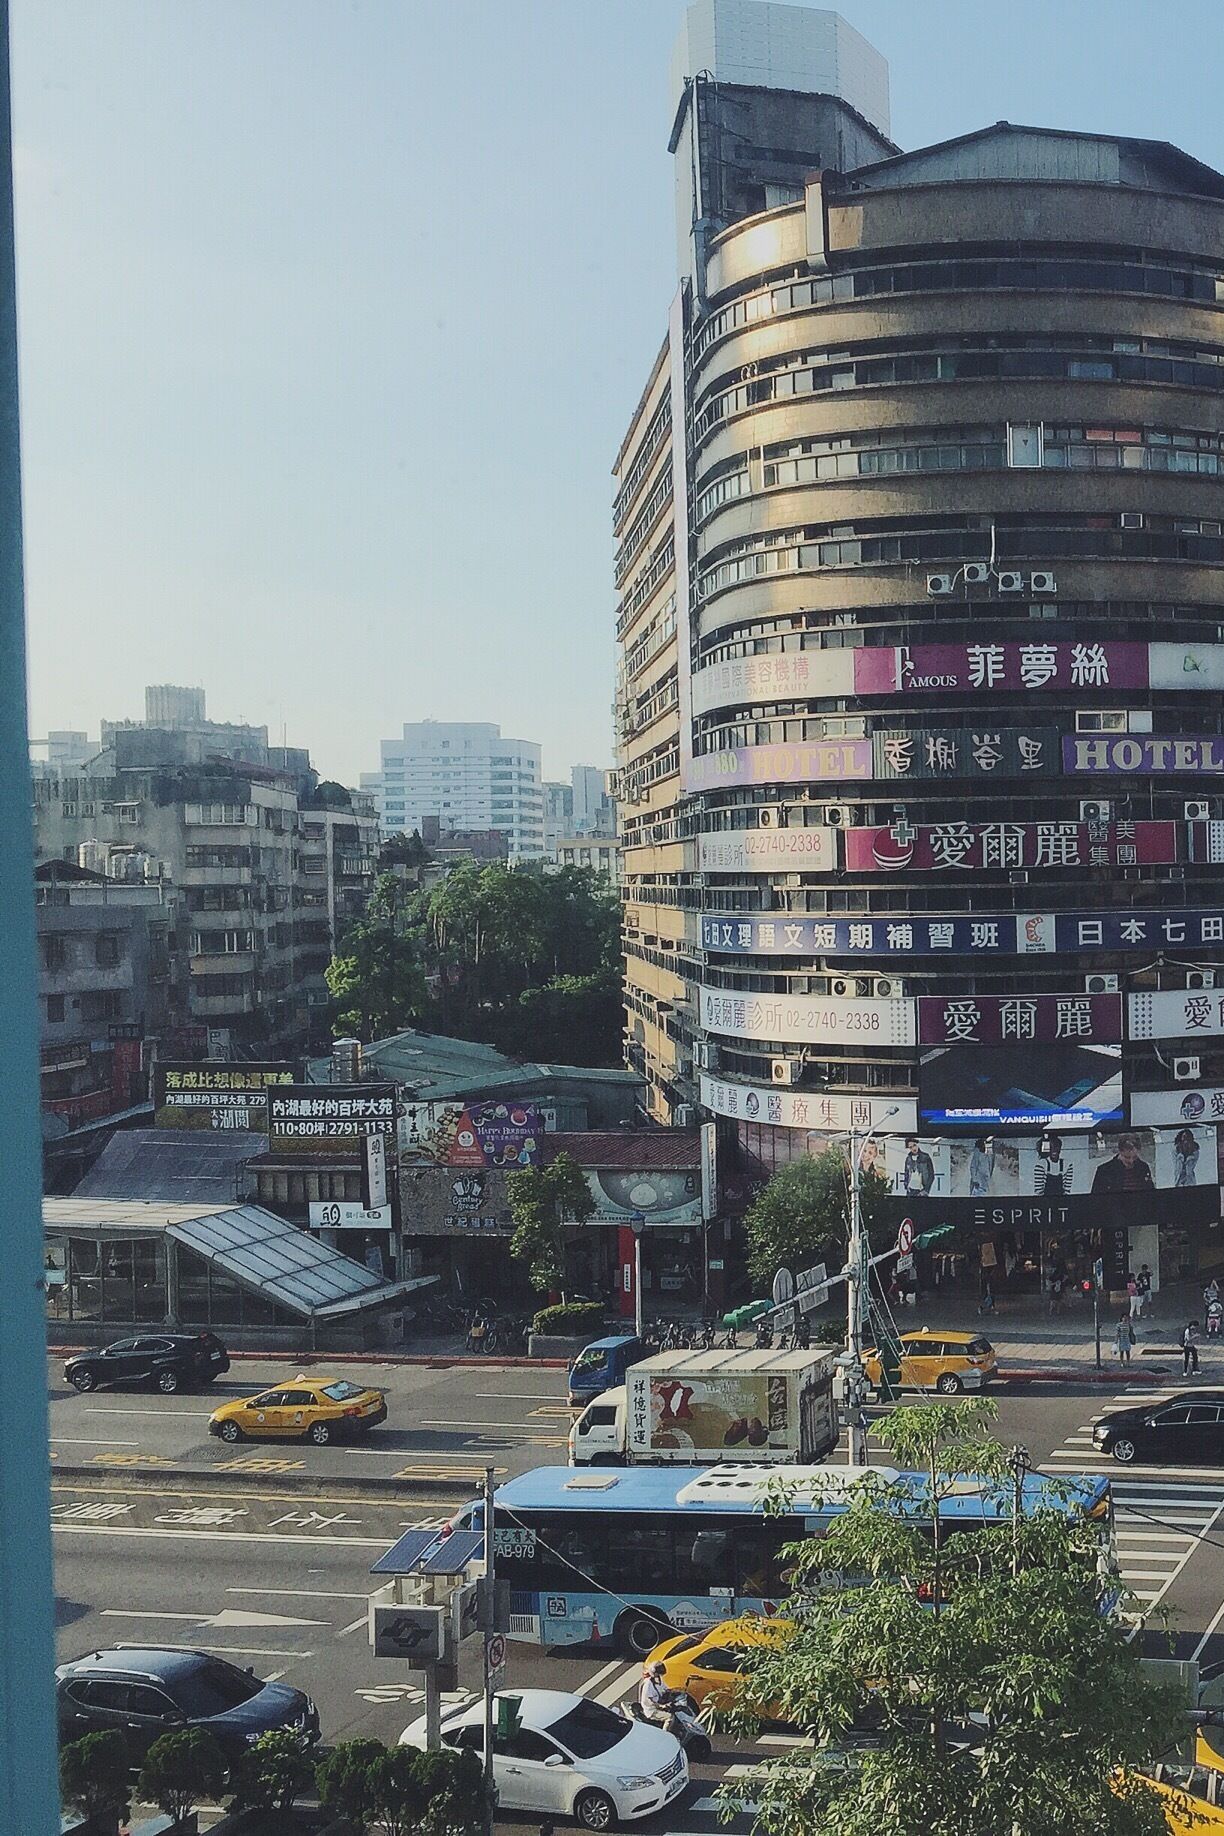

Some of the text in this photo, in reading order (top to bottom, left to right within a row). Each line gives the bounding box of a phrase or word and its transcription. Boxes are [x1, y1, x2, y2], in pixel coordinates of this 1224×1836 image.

[967, 643, 1110, 689] 菲夢絲
[752, 745, 868, 779] HOTEL
[1074, 739, 1224, 771] HOTEL
[744, 833, 822, 855] 02-2740-2338
[929, 821, 1081, 869] 愛爾麗
[786, 1008, 880, 1031] 02-2740-2338
[943, 997, 1092, 1043] 愛爾麗
[975, 1207, 1069, 1225] ESPRIT
[632, 1379, 647, 1445] 祥億貨運
